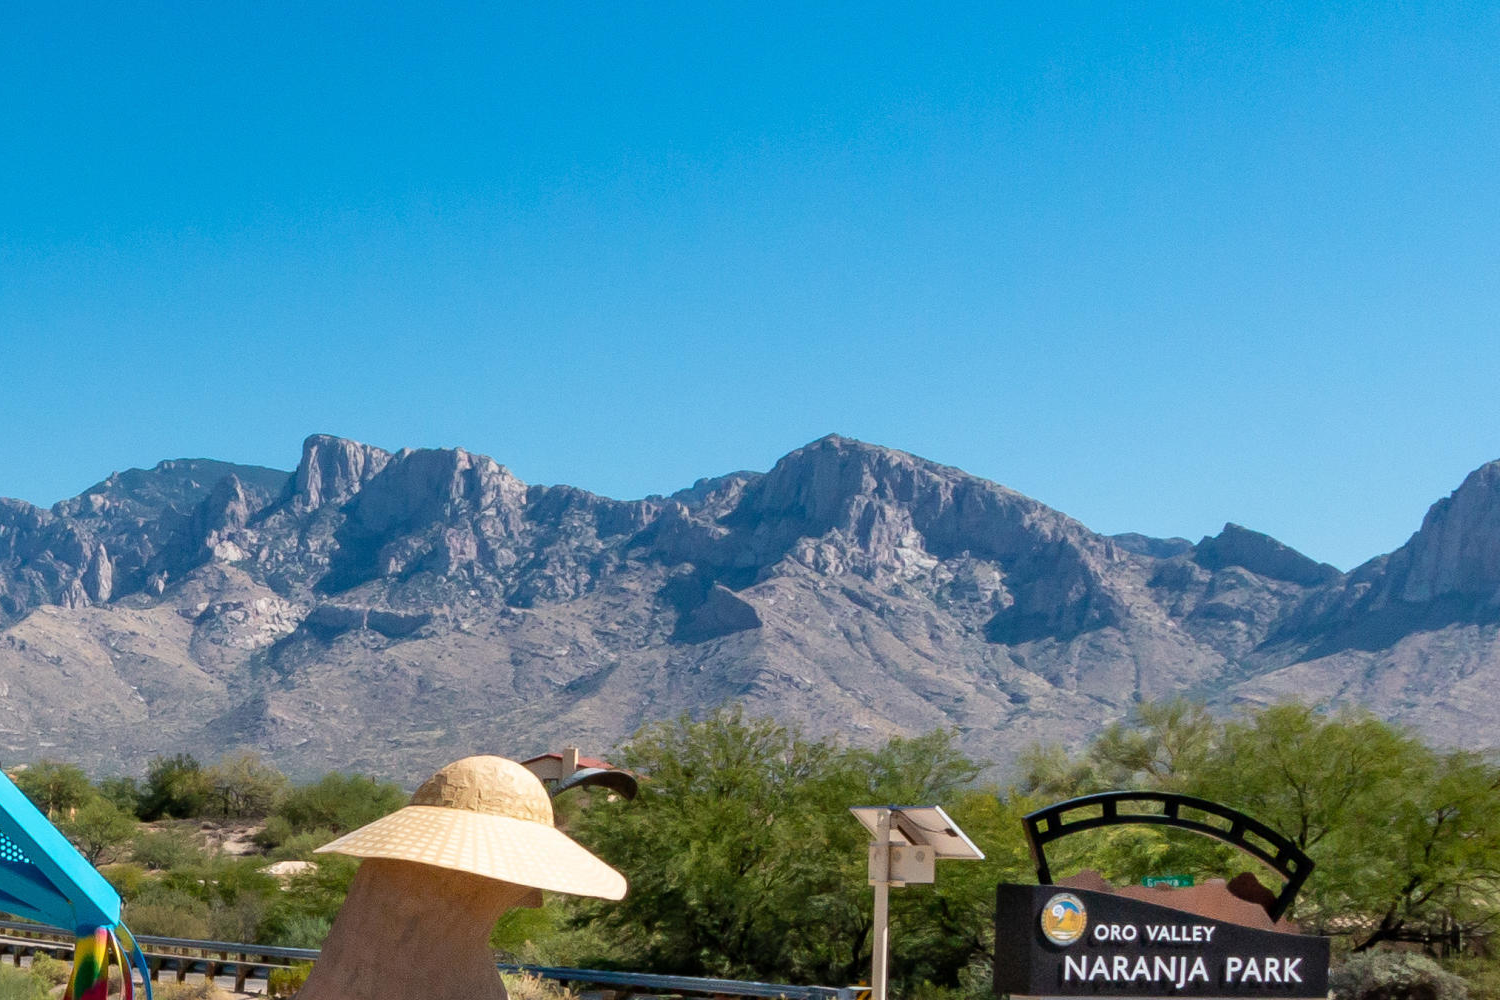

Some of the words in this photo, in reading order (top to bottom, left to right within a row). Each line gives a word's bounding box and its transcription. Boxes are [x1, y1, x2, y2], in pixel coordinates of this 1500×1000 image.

[1094, 924, 1137, 941] ORO
[1146, 925, 1216, 942] VALLEY
[1064, 955, 1209, 989] NARANJA
[1225, 957, 1302, 982] PARK
